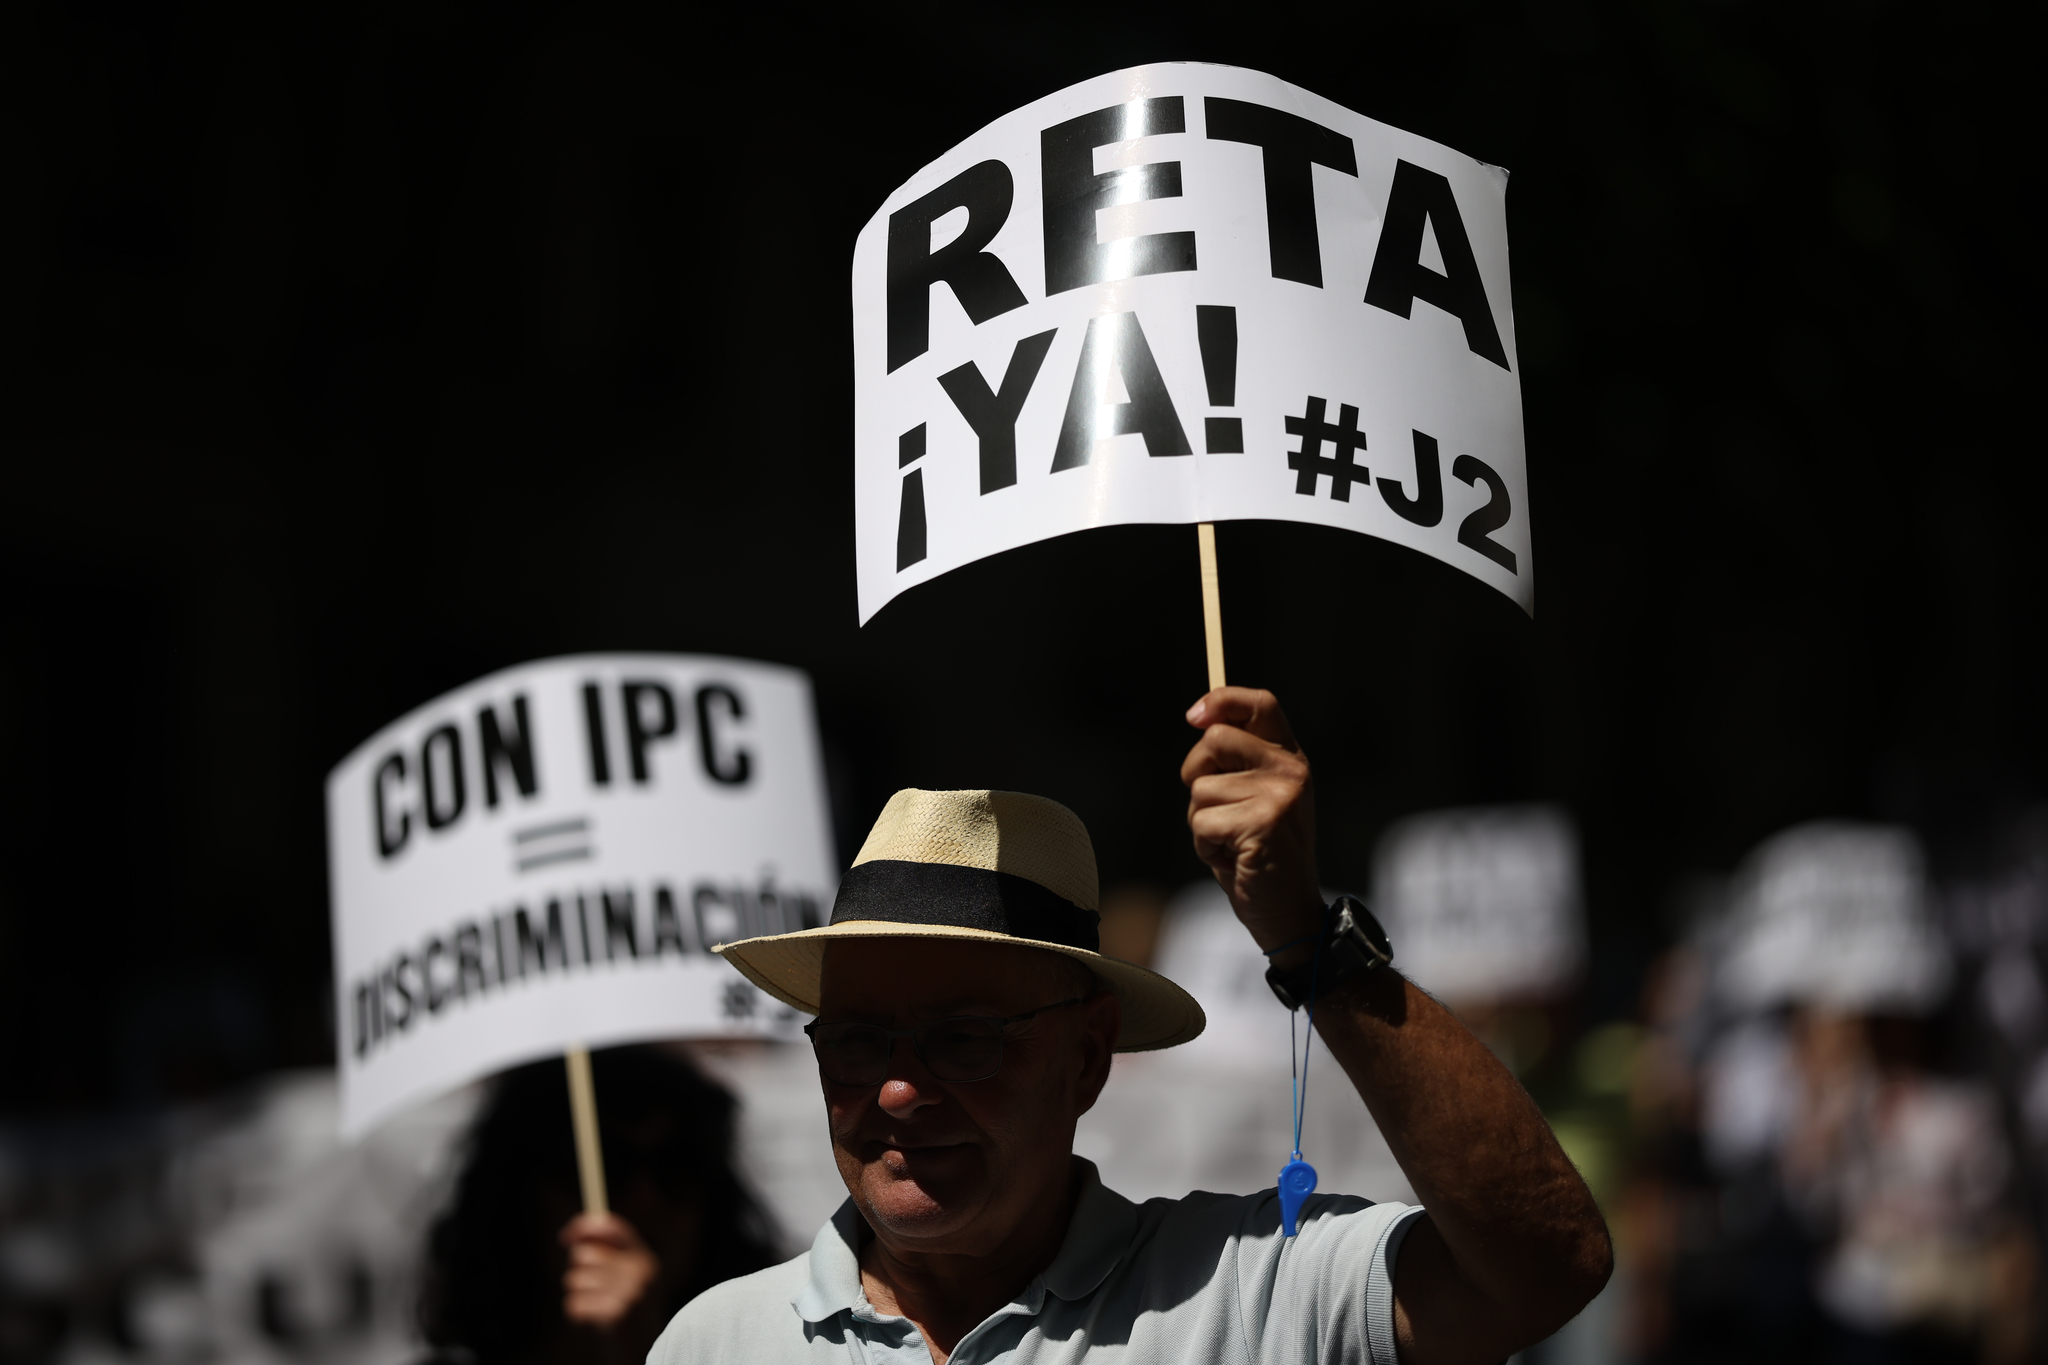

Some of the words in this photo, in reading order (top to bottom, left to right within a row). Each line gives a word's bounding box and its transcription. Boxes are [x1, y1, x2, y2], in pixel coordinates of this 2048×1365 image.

[887, 96, 1511, 375] RETA
[897, 305, 1244, 574] ¡YA!
[1285, 395, 1518, 577] #J2
[374, 696, 537, 858] CON
[581, 677, 752, 785] IPC
